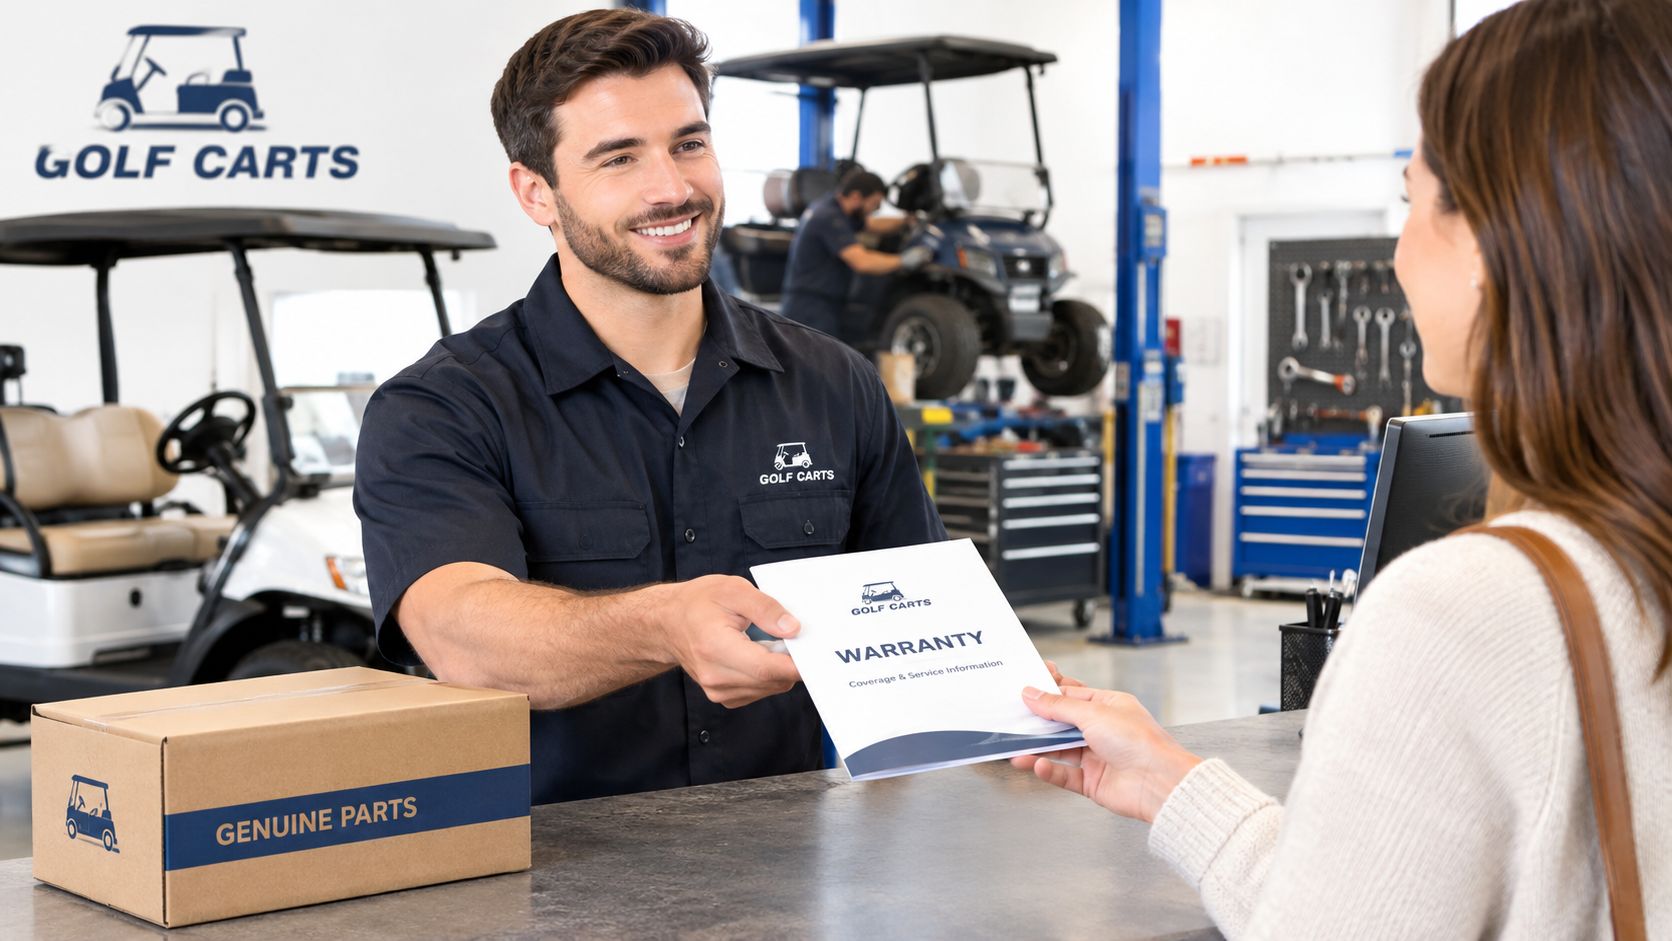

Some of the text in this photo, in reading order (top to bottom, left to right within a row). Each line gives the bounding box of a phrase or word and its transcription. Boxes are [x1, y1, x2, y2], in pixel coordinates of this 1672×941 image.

[34, 145, 360, 179] GOLF CARTS
[759, 470, 835, 485] GOLF CARTS
[851, 598, 932, 616] GOLF CARTS
[835, 630, 983, 663] WARRANTY
[848, 658, 1004, 689] Coverage & Service Information
[216, 796, 418, 846] GENUINE PARTS
